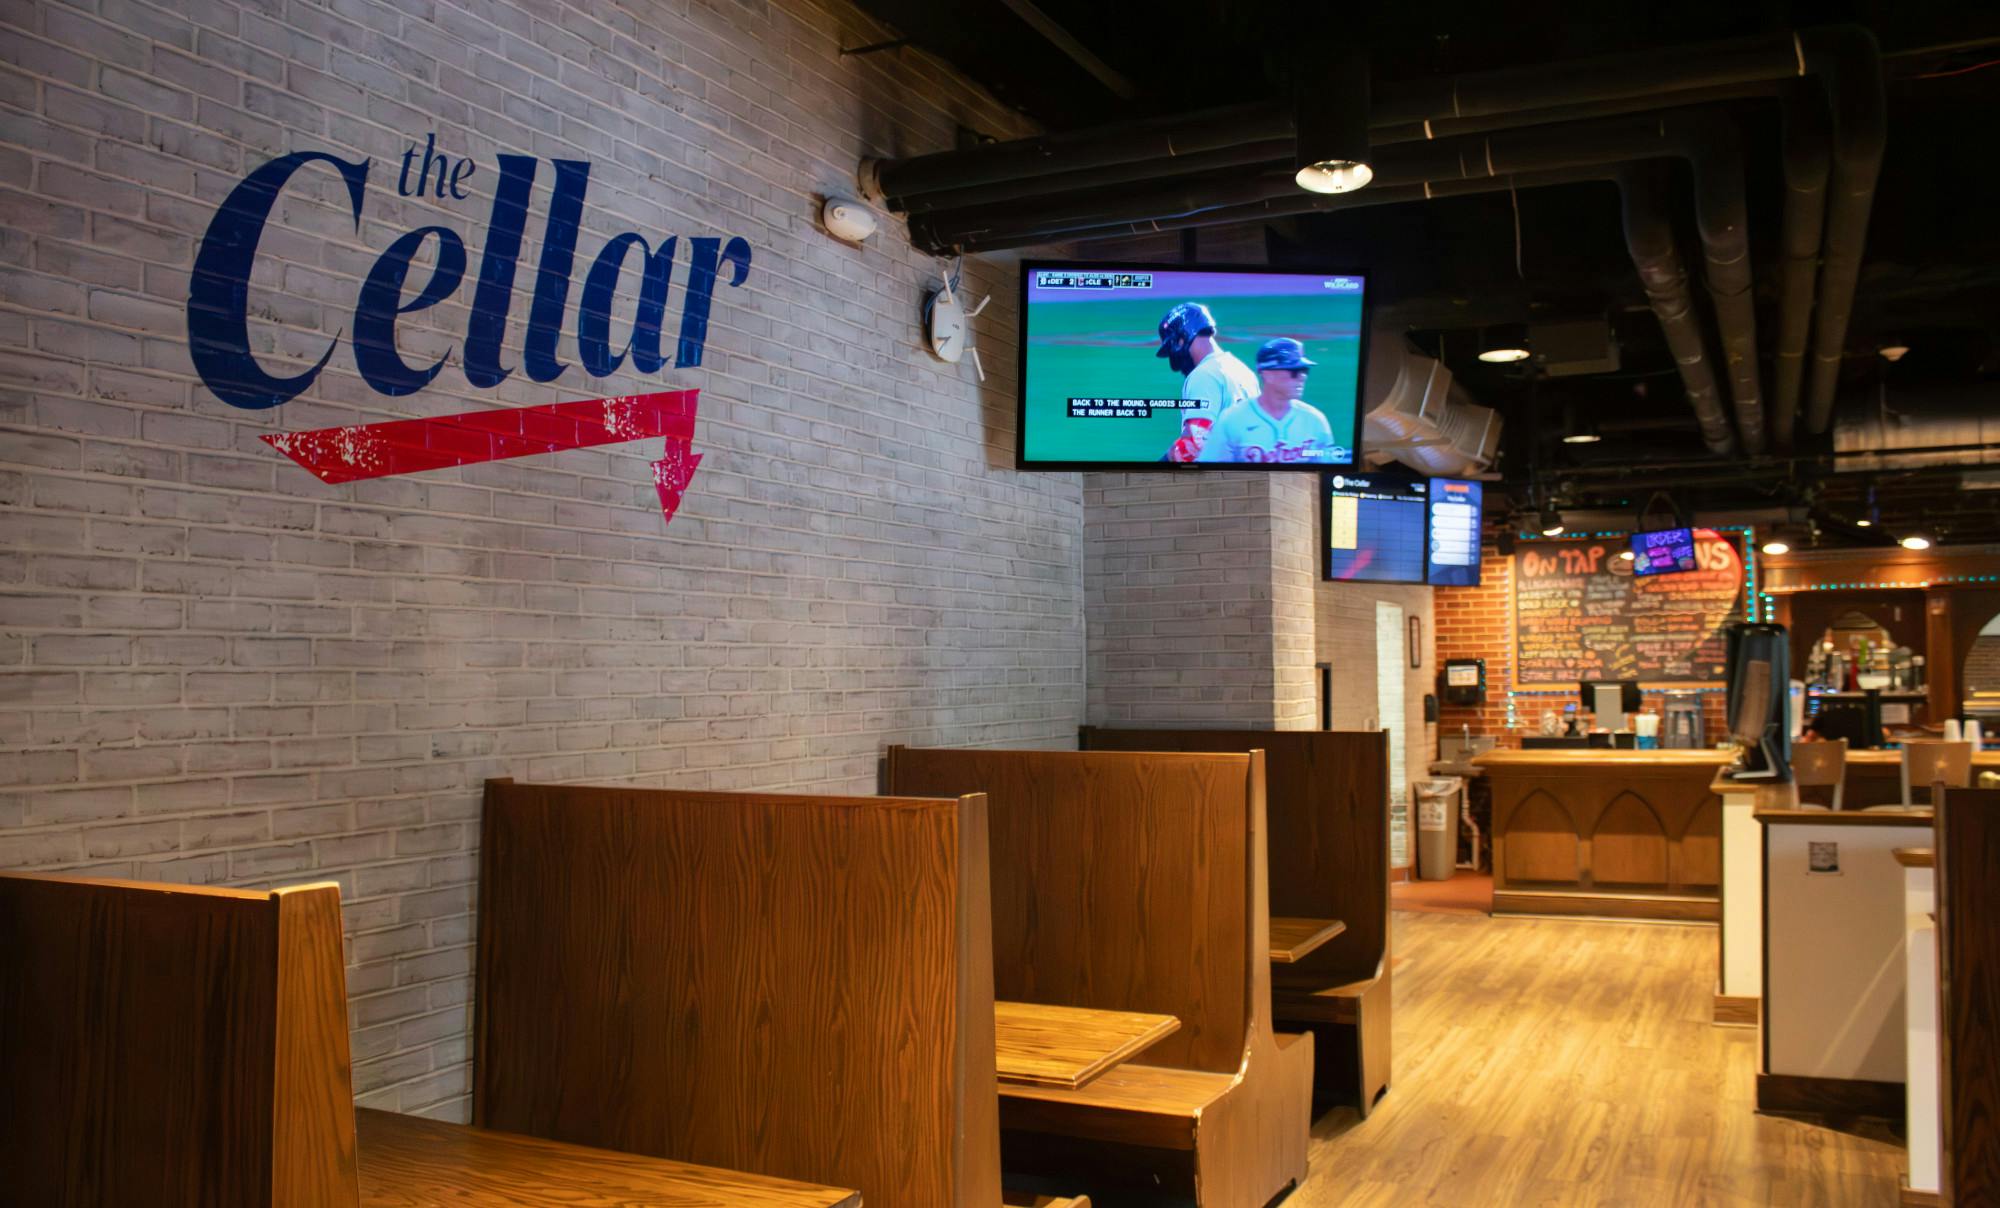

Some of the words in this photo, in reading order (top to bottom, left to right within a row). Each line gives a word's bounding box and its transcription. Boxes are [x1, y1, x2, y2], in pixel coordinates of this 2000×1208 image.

[397, 132, 477, 201] the
[187, 150, 752, 410] Cellar
[1072, 399, 1091, 407] BACK
[1178, 400, 1197, 408] LOOK
[1558, 546, 1605, 574] TAP
